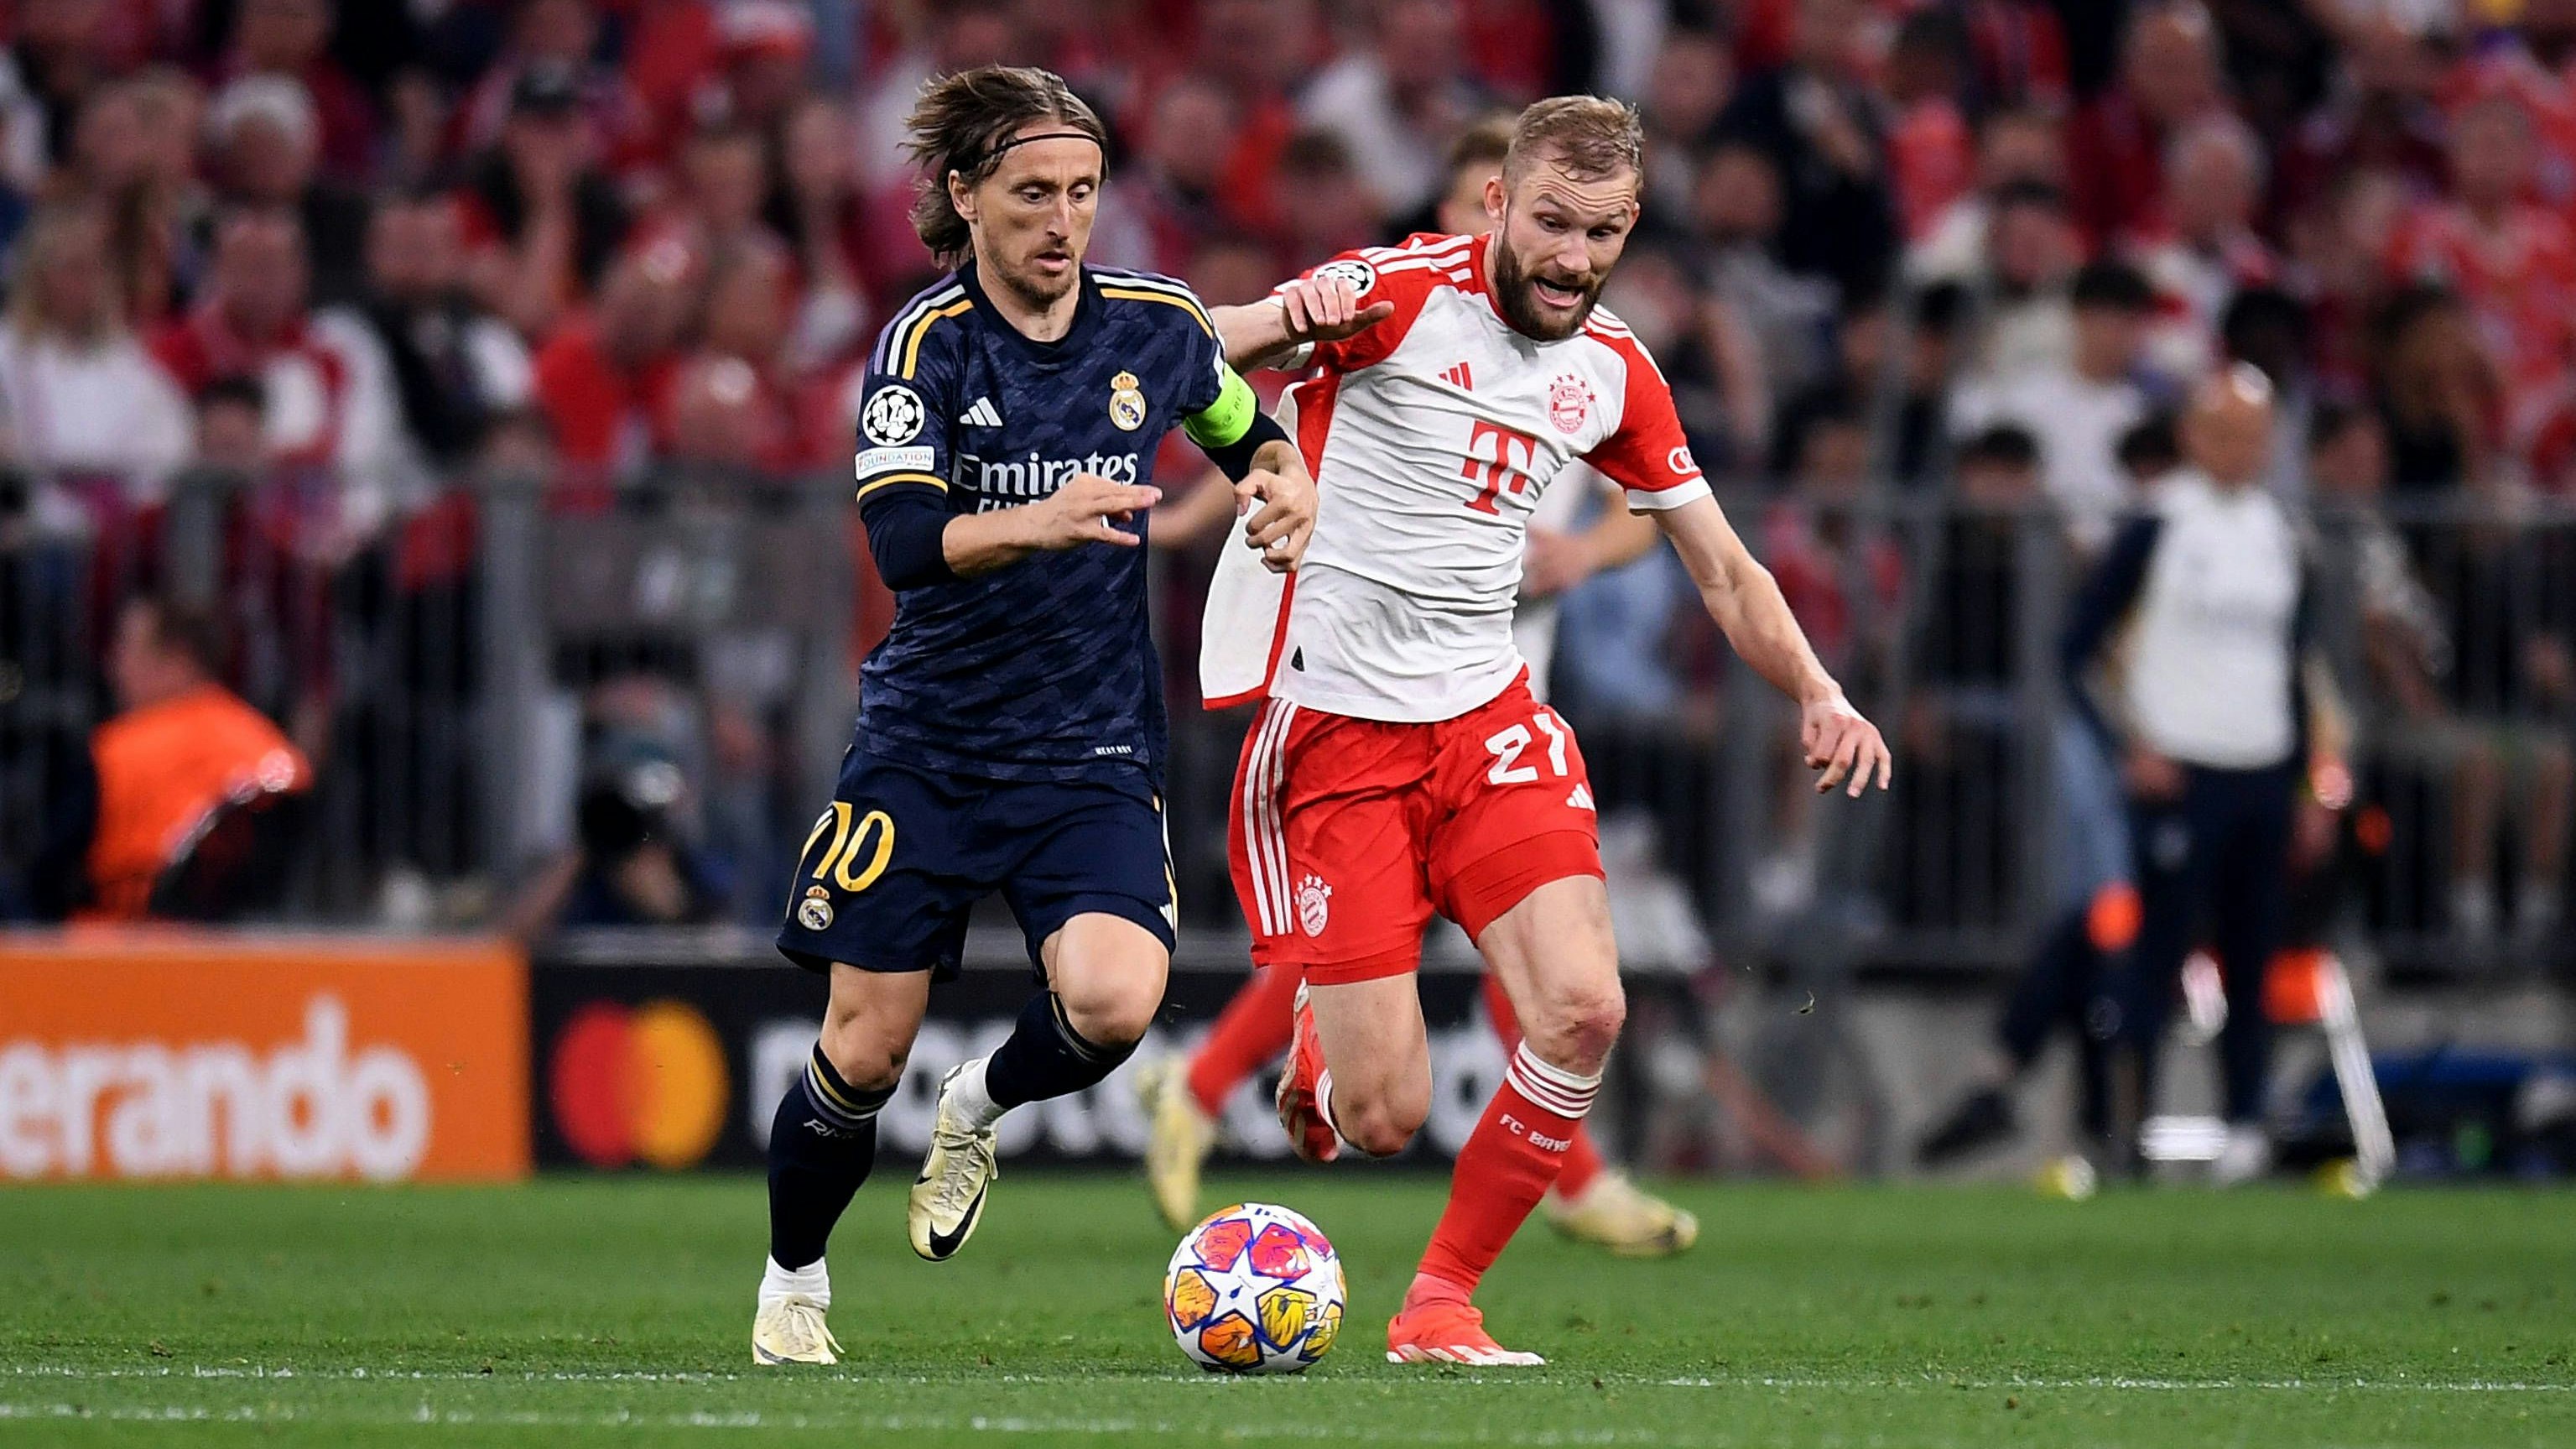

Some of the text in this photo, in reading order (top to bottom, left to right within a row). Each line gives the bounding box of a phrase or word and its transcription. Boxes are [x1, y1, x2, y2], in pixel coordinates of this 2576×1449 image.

[858, 453, 931, 471] FOUNDATION
[952, 449, 1138, 496] Emirates
[812, 800, 896, 893] 10
[0, 993, 432, 1179] erando
[1499, 1113, 1525, 1135] FC
